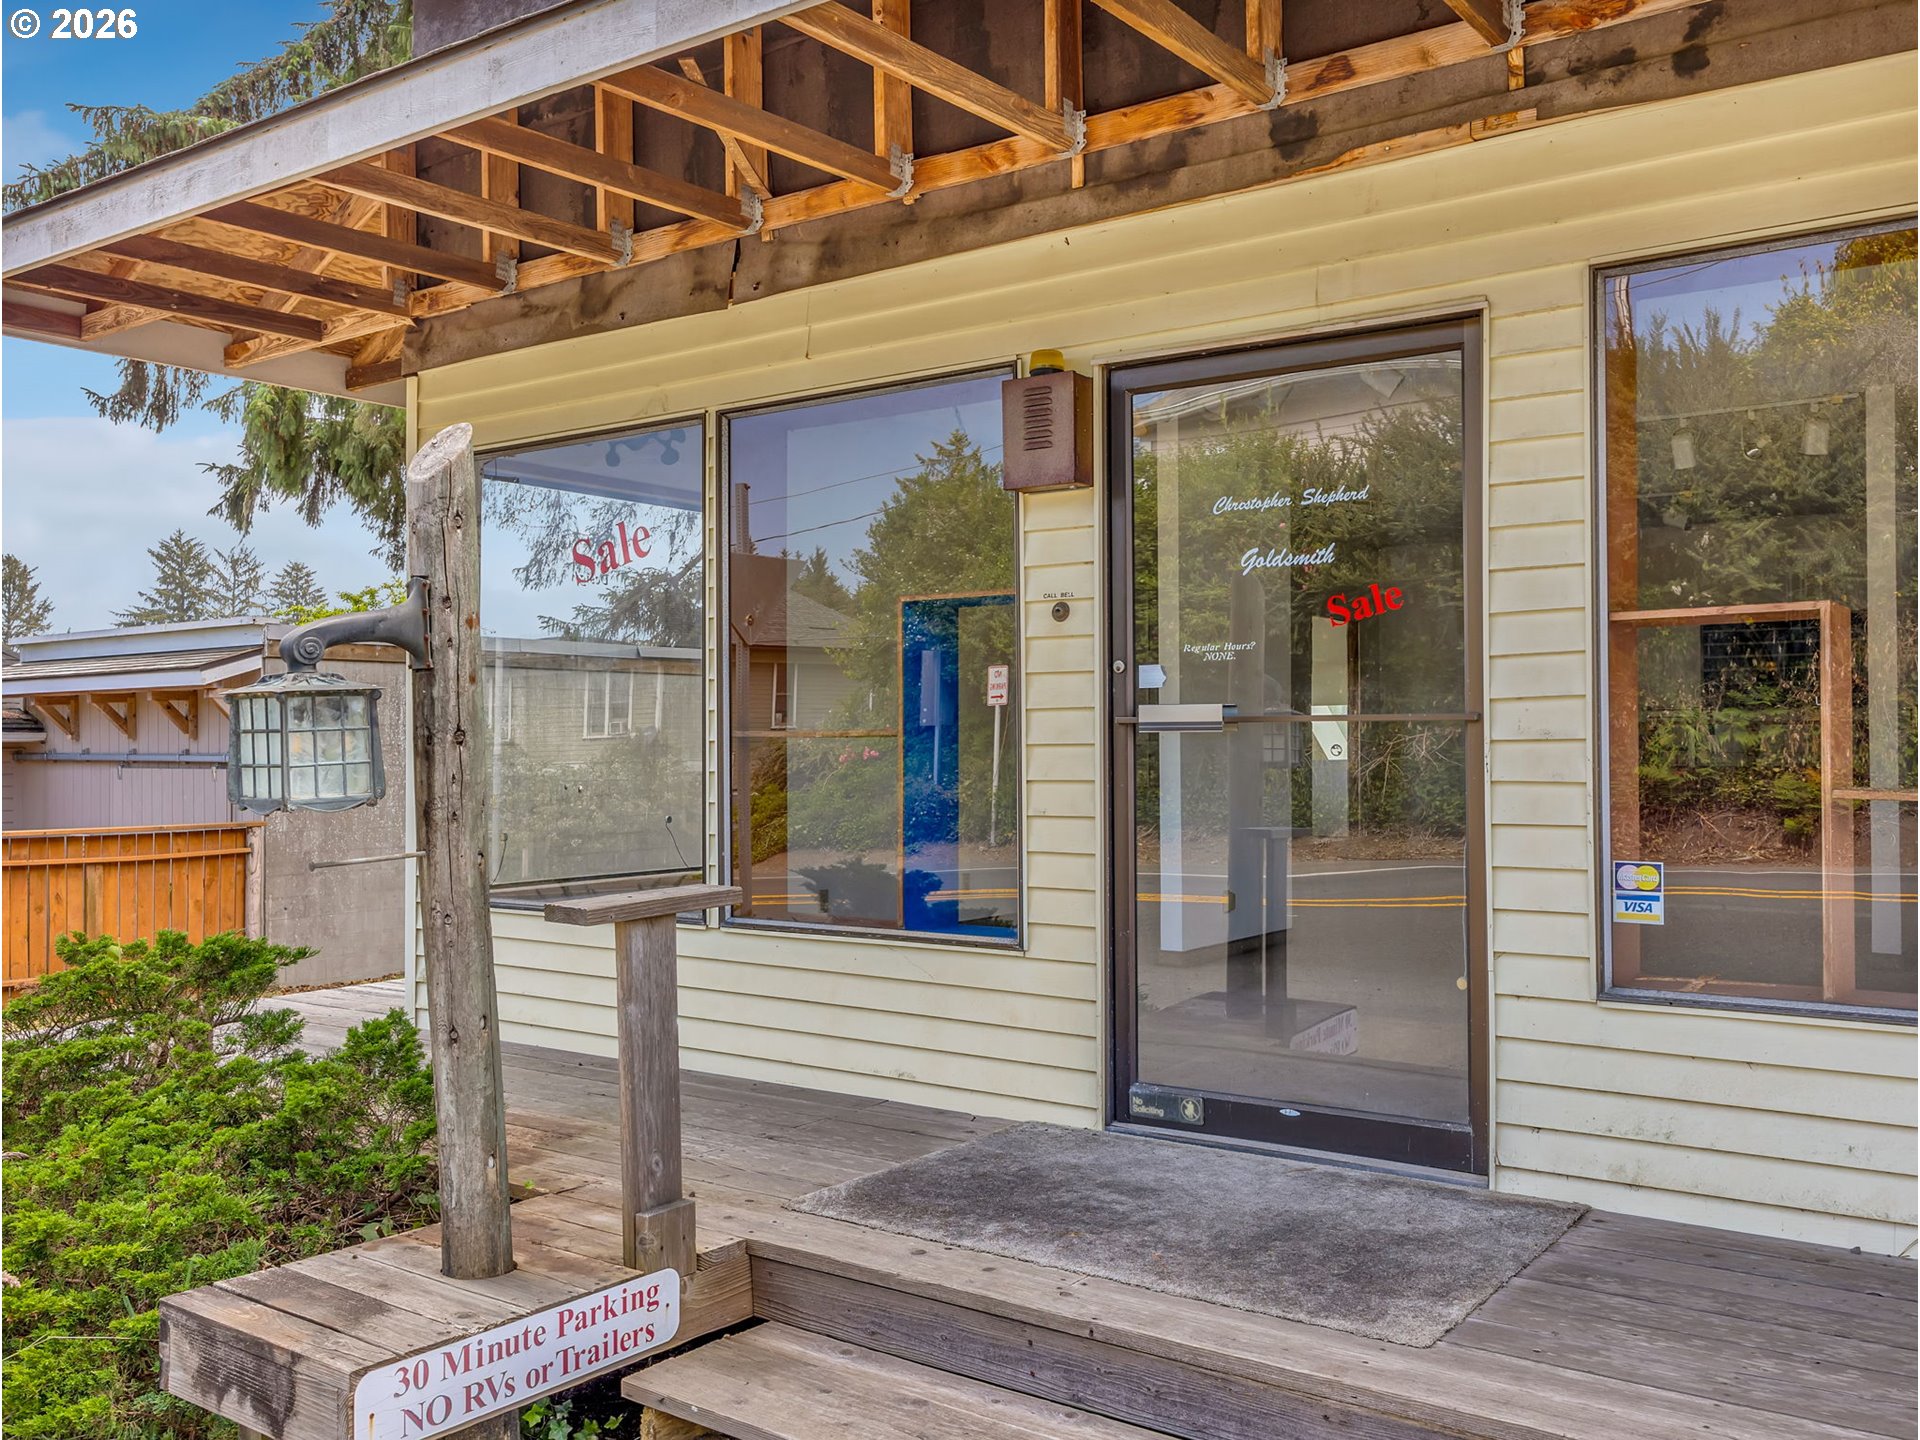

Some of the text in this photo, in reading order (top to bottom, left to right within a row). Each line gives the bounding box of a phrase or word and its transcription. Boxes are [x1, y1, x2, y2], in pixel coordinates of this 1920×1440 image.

[1300, 484, 1370, 507] Shepherd
[572, 521, 652, 586] Sale
[1240, 542, 1336, 576] Goldsmith
[1326, 583, 1405, 627] Sale
[1183, 641, 1256, 654] Regular Hours?
[1203, 651, 1236, 662] NONE.
[1623, 901, 1653, 913] VISA
[1132, 1096, 1143, 1105] No
[1132, 1105, 1164, 1117] Soliciting
[393, 1283, 660, 1398] 30 Minute Parking
[400, 1322, 655, 1440] NO RVs or Trailers
